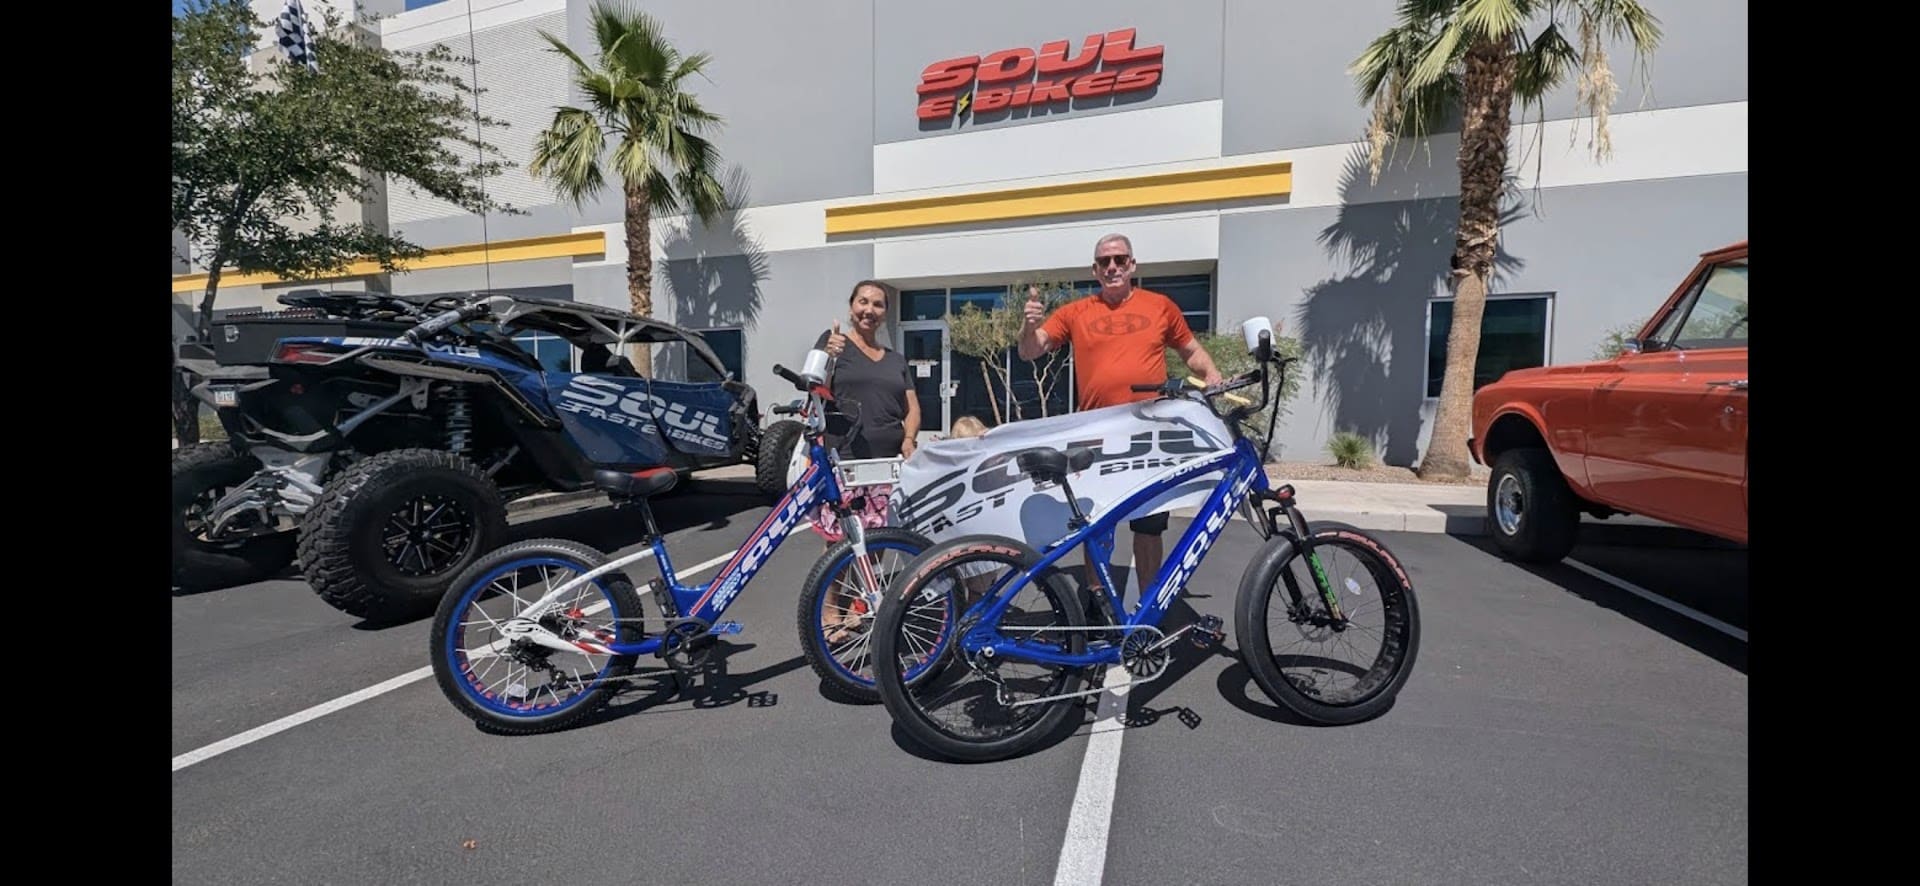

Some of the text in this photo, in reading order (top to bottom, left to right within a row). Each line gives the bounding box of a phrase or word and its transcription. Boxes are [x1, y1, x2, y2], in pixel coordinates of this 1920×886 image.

[916, 27, 1165, 95] SOUL
[917, 63, 1165, 119] E BIKES
[560, 375, 729, 442] SOUL
[711, 476, 827, 612] SOUL
[1156, 466, 1257, 612] SOUL
